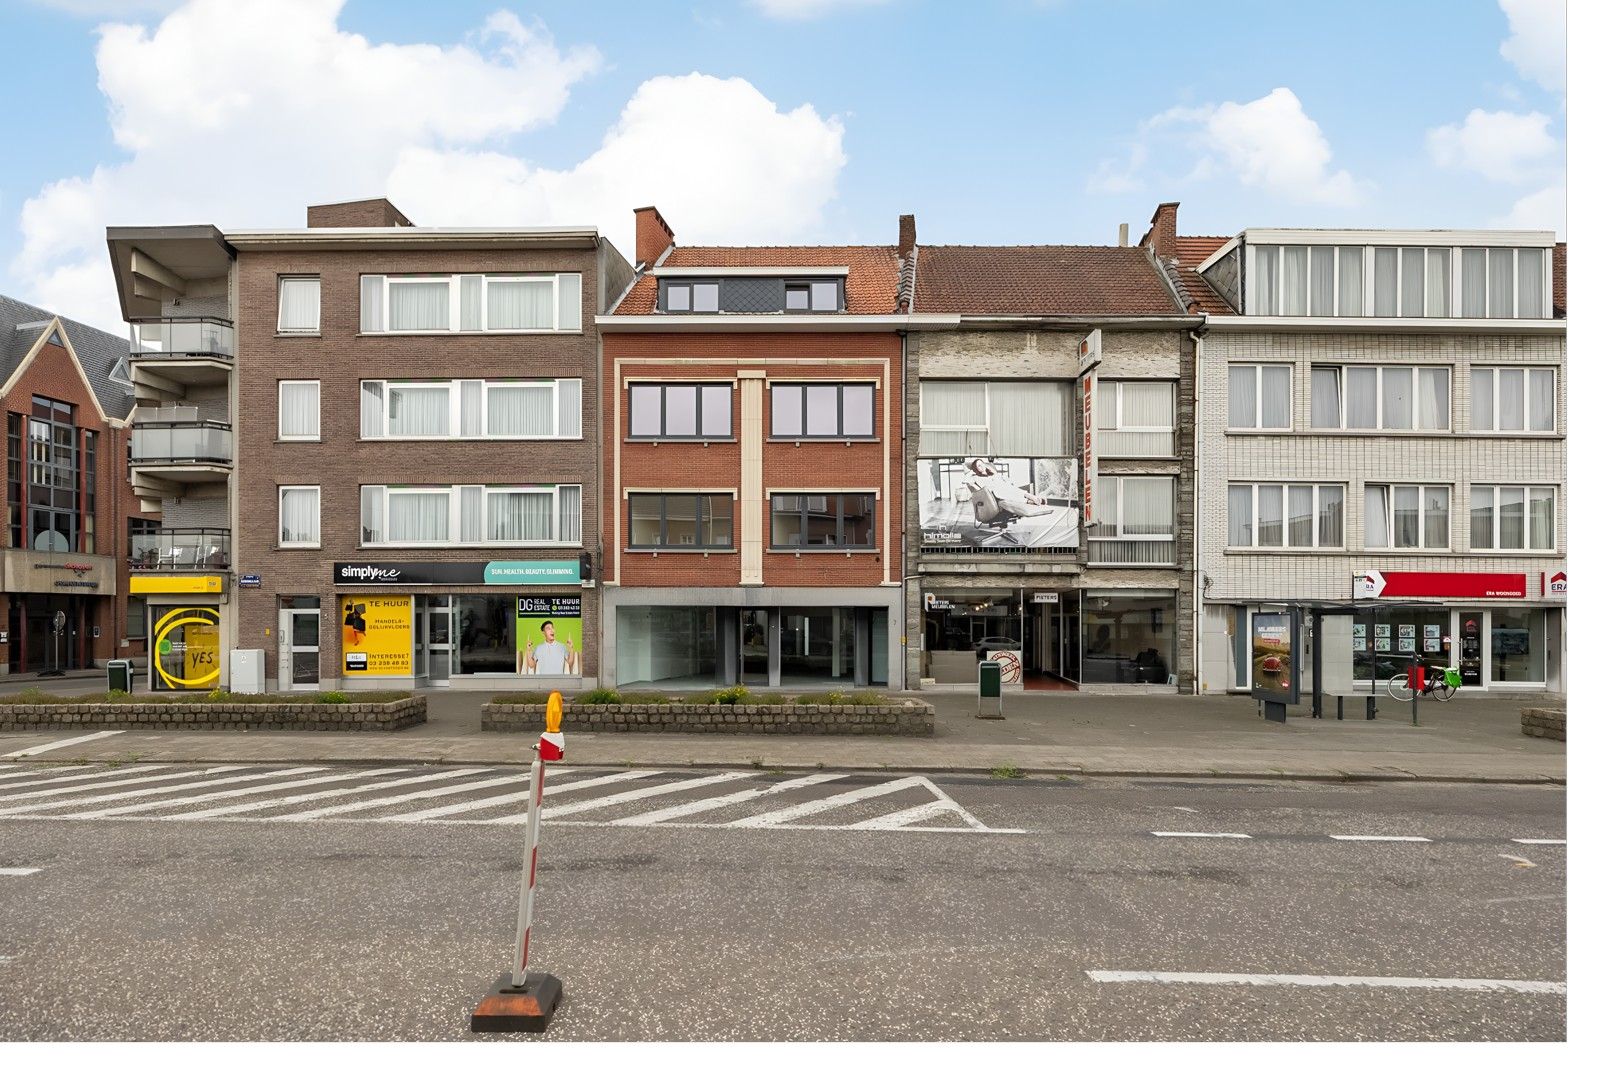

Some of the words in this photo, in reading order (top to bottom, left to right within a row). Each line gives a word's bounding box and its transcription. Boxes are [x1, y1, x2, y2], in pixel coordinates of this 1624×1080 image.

[1084, 376, 1092, 522] MEUBELEN
[519, 598, 533, 611] DG
[192, 651, 213, 668] YES
